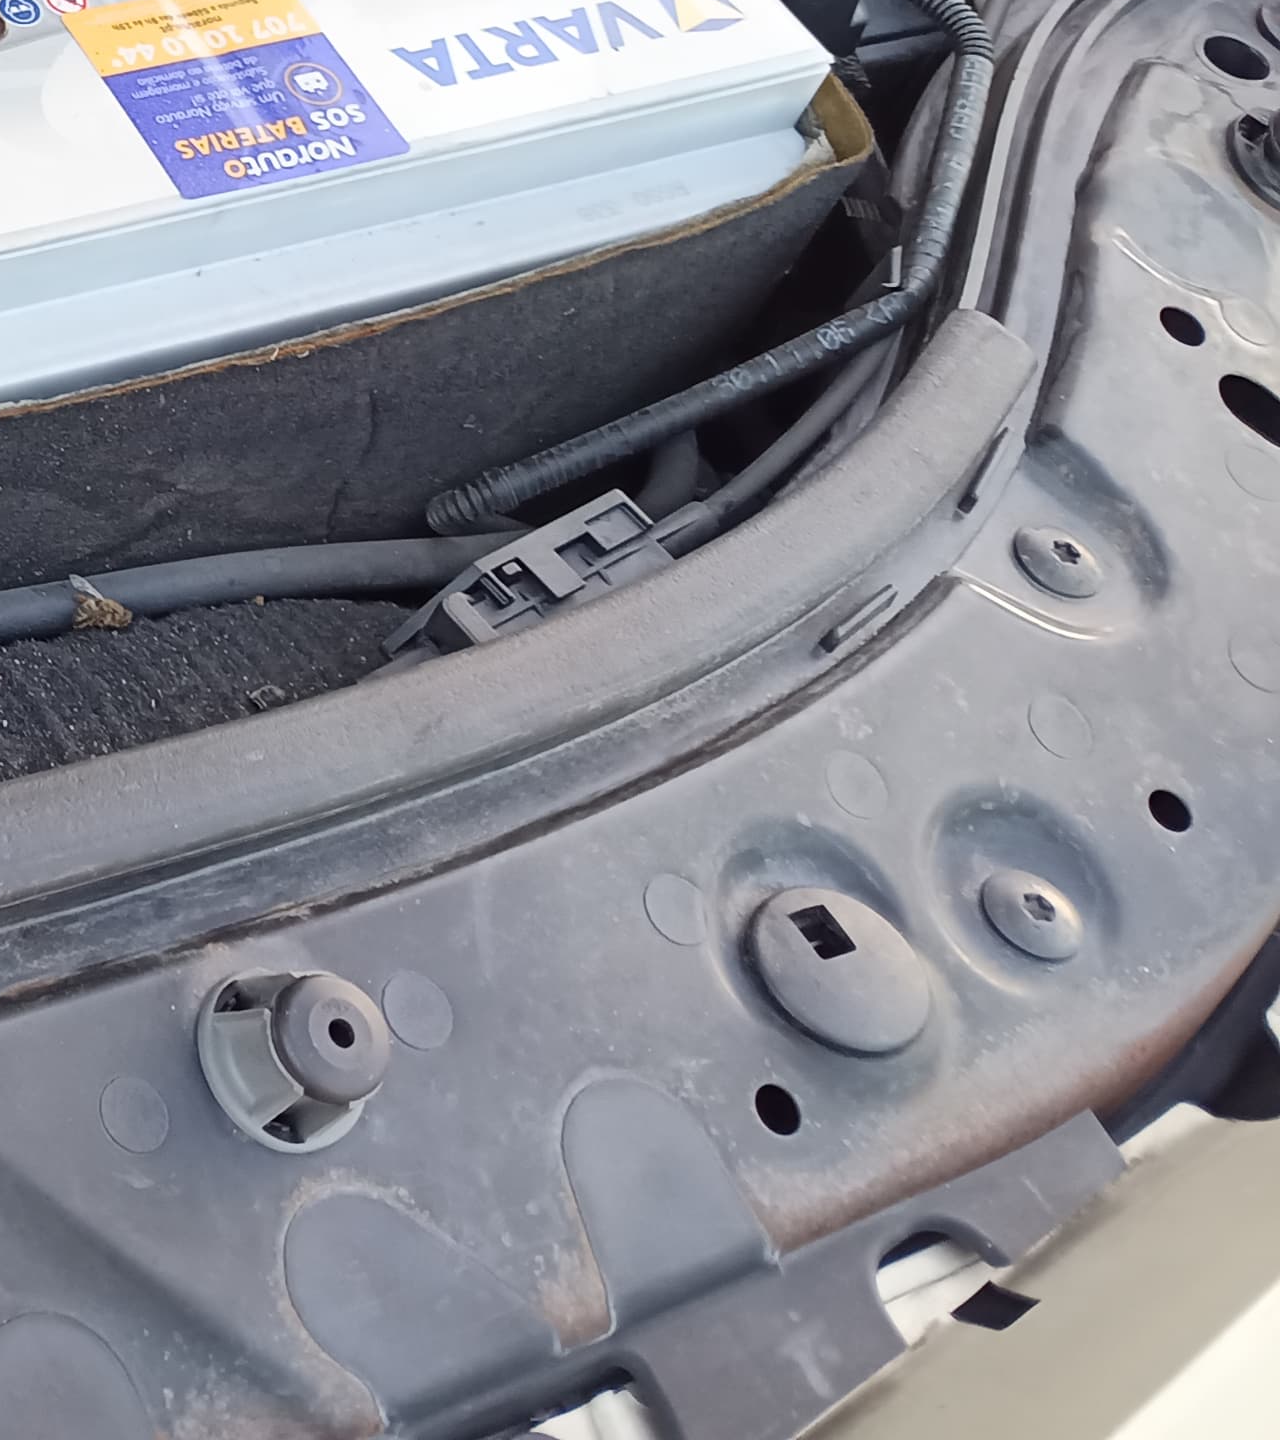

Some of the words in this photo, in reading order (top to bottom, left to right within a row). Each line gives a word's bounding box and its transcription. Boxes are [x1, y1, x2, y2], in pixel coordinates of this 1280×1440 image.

[203, 25, 244, 49] 10
[252, 12, 307, 40] 707
[389, 0, 664, 87] VARTA
[246, 55, 258, 64] da
[131, 82, 191, 99] montagem
[252, 78, 275, 90] que
[258, 91, 286, 103] Um
[155, 106, 212, 124] Norauto
[309, 103, 366, 131] SOS
[174, 115, 309, 160] BATERIAS
[223, 136, 357, 180] Norauto
